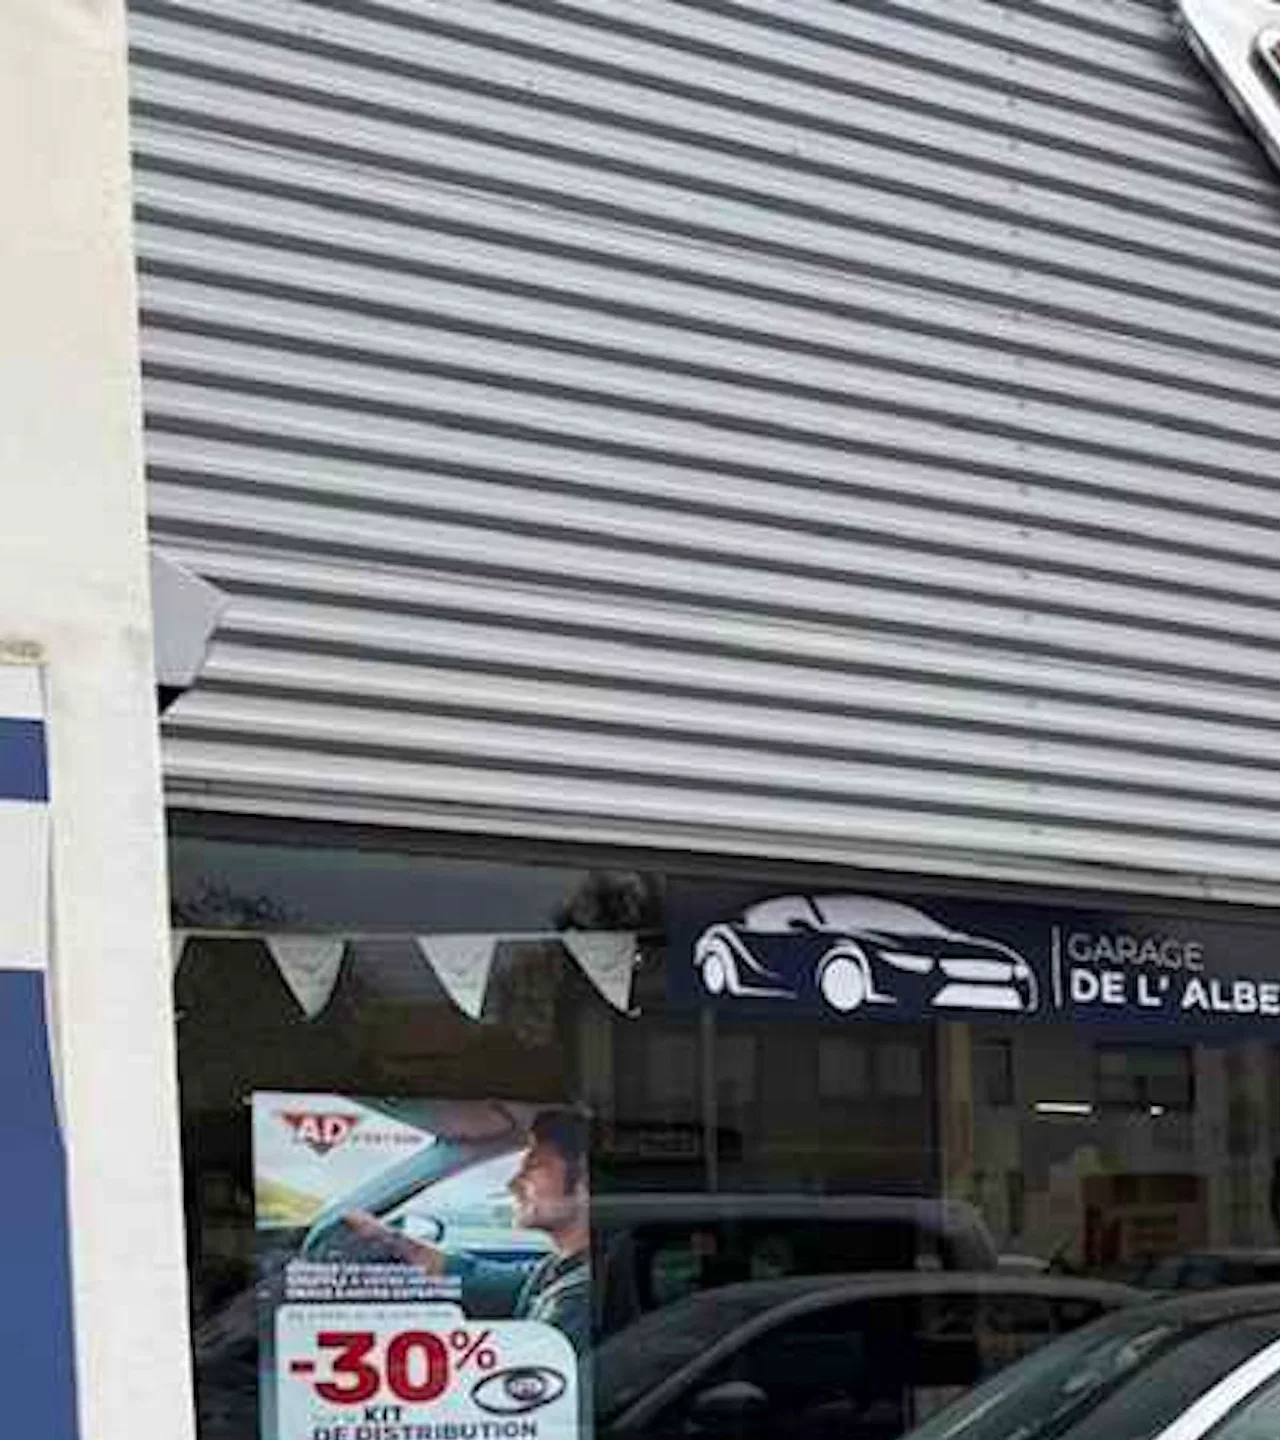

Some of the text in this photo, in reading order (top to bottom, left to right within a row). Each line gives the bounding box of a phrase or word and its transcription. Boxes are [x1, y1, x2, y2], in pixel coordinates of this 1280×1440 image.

[1067, 932, 1205, 972] GARAGE
[1071, 967, 1128, 1004] DE
[302, 1114, 348, 1143] AD
[290, 1329, 496, 1404] -30%
[363, 1404, 402, 1422] KIT
